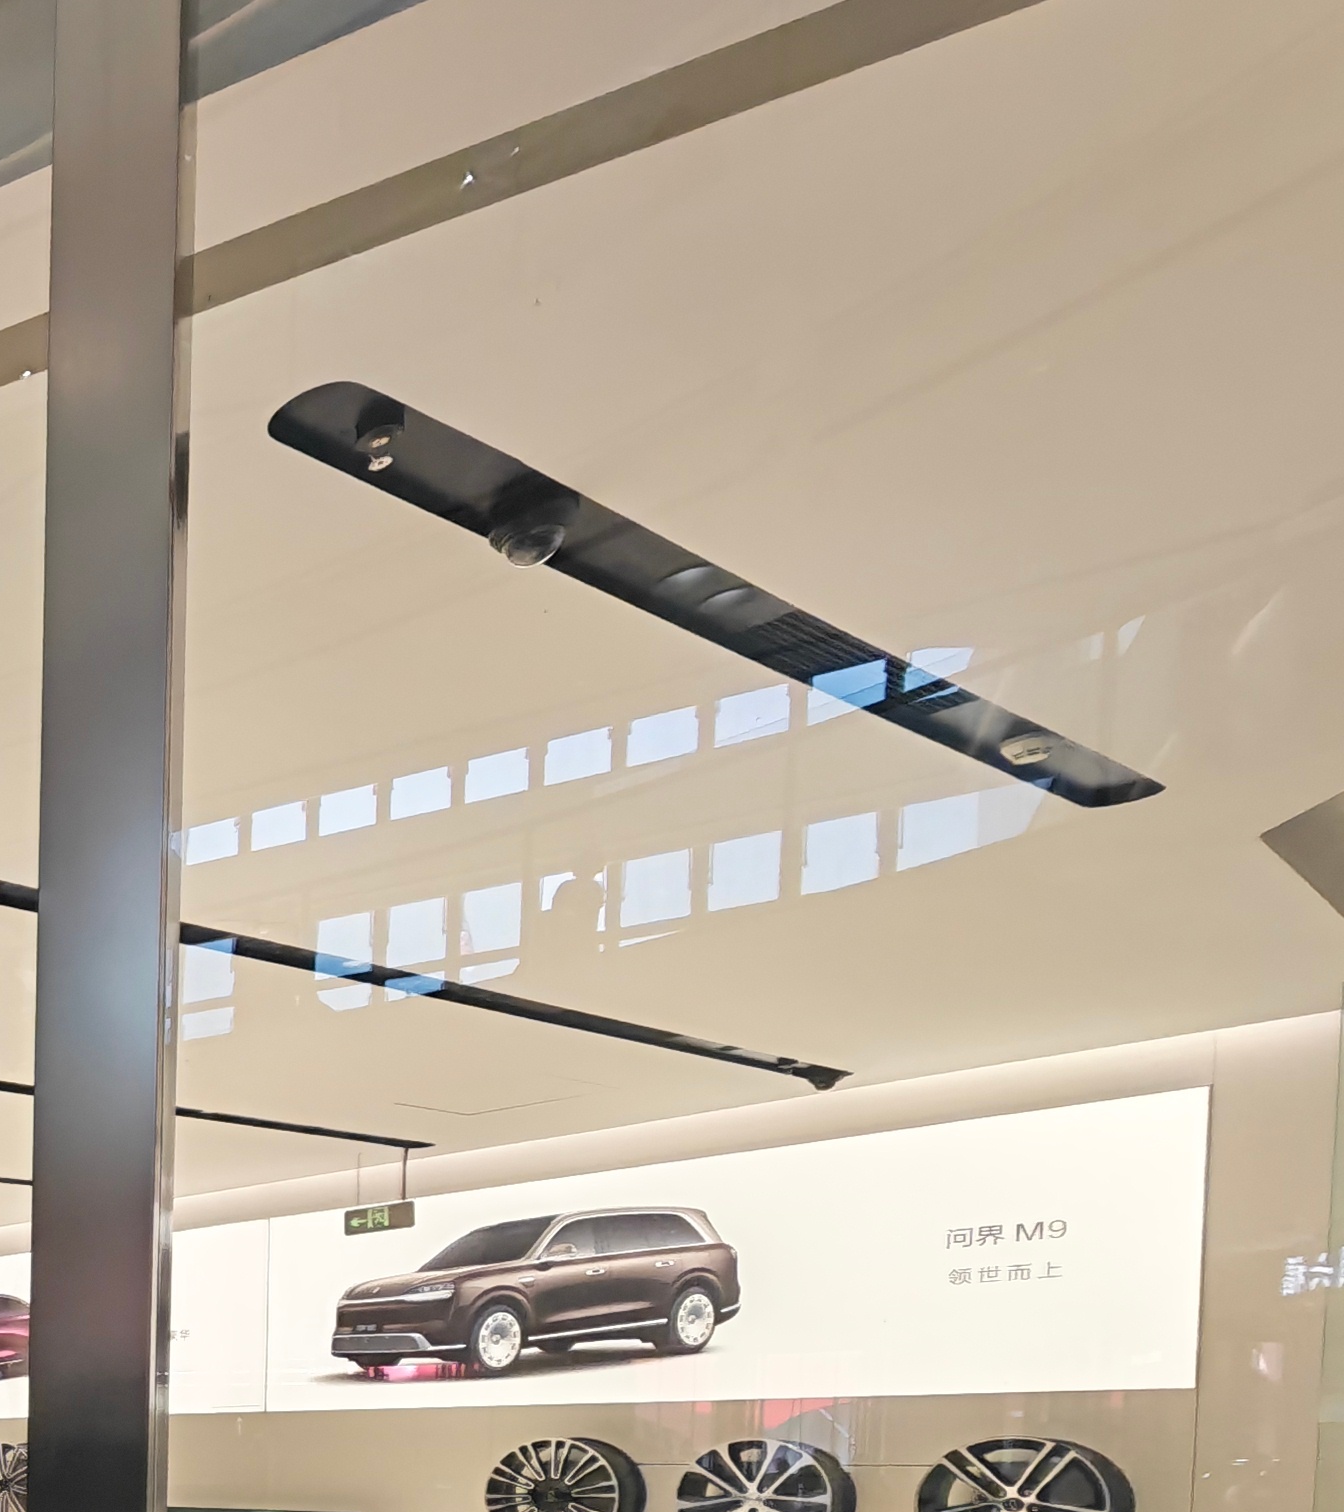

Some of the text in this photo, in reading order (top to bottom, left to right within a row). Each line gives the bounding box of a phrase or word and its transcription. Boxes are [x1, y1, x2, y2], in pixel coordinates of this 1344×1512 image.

[945, 1219, 1068, 1250] 问界 M9
[948, 1261, 1063, 1286] 领世而上
